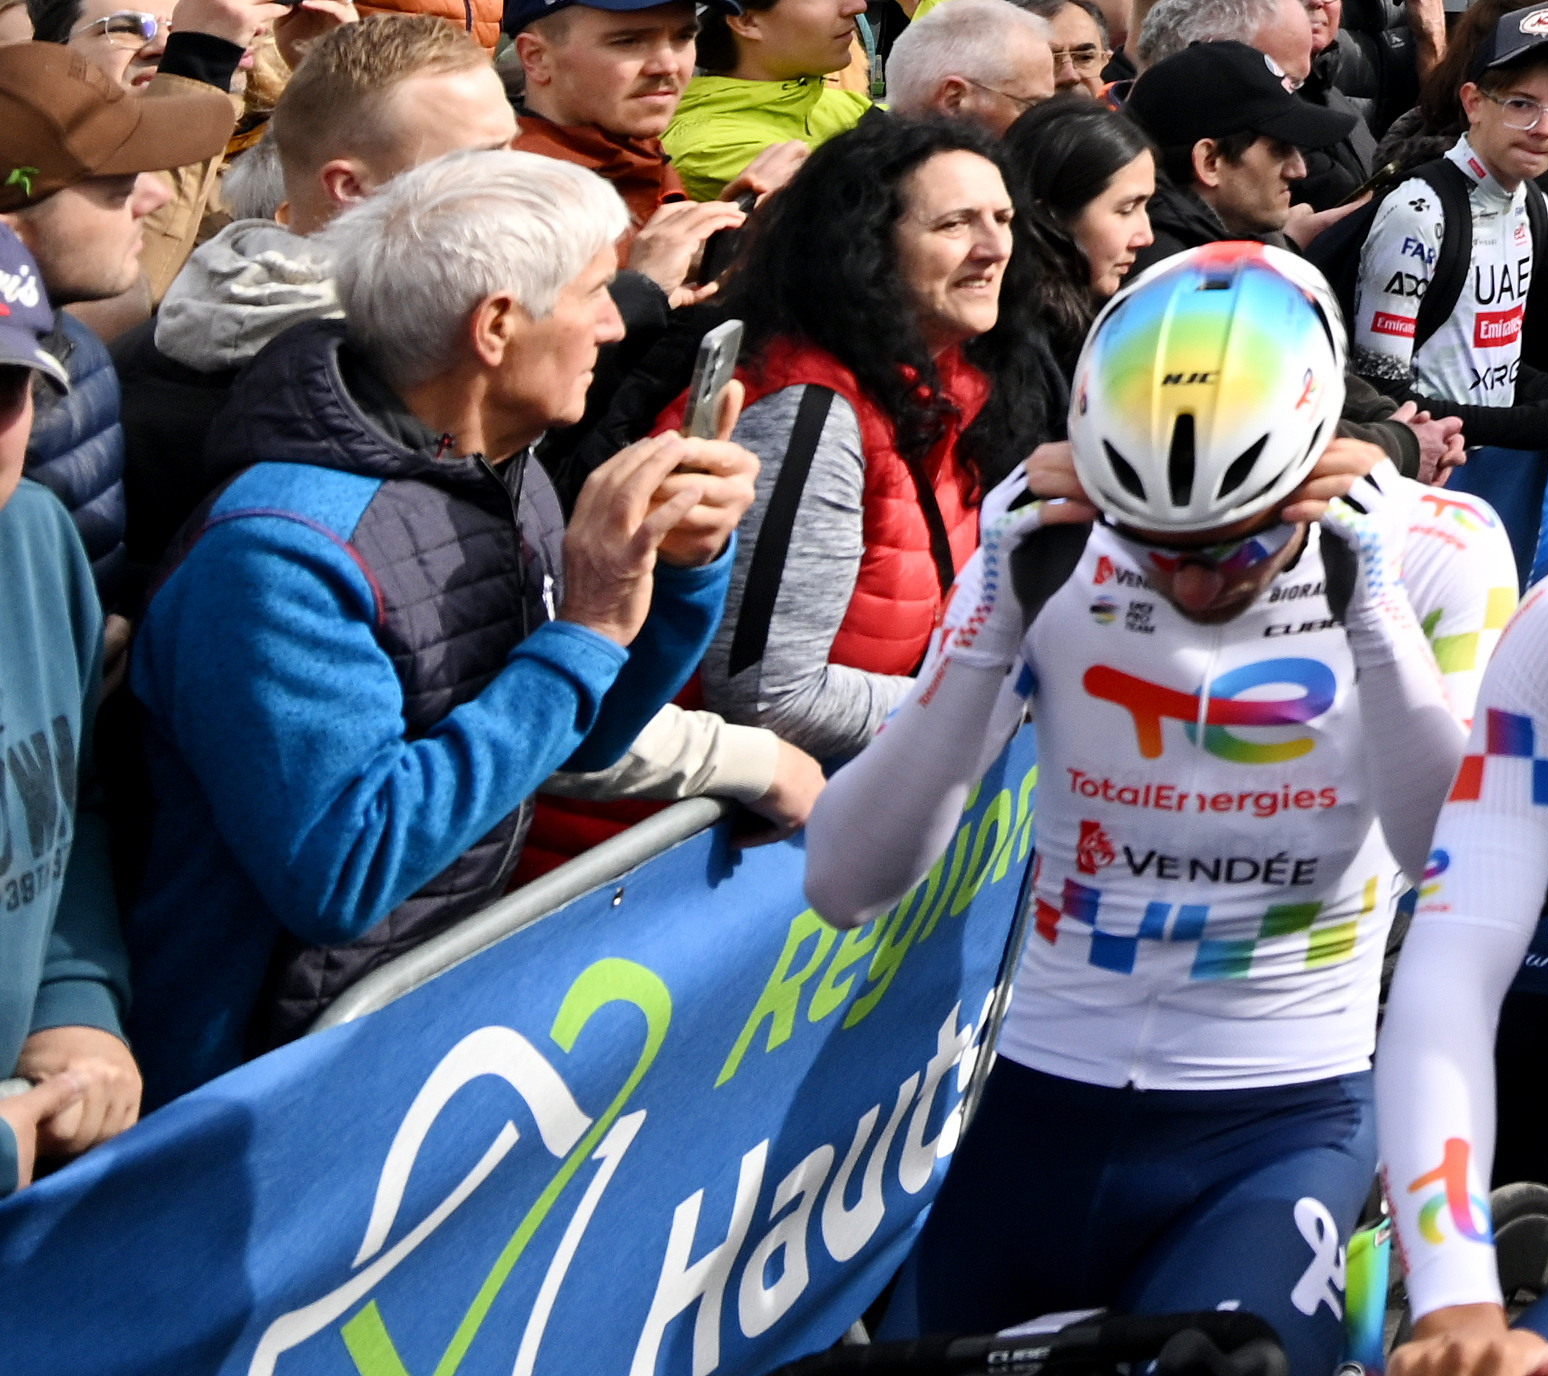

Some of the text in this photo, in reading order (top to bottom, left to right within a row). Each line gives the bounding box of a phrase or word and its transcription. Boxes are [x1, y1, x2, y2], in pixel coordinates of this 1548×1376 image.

[1474, 256, 1532, 307] UAE
[1161, 368, 1221, 386] HJC
[1123, 845, 1319, 887] VENDÉE
